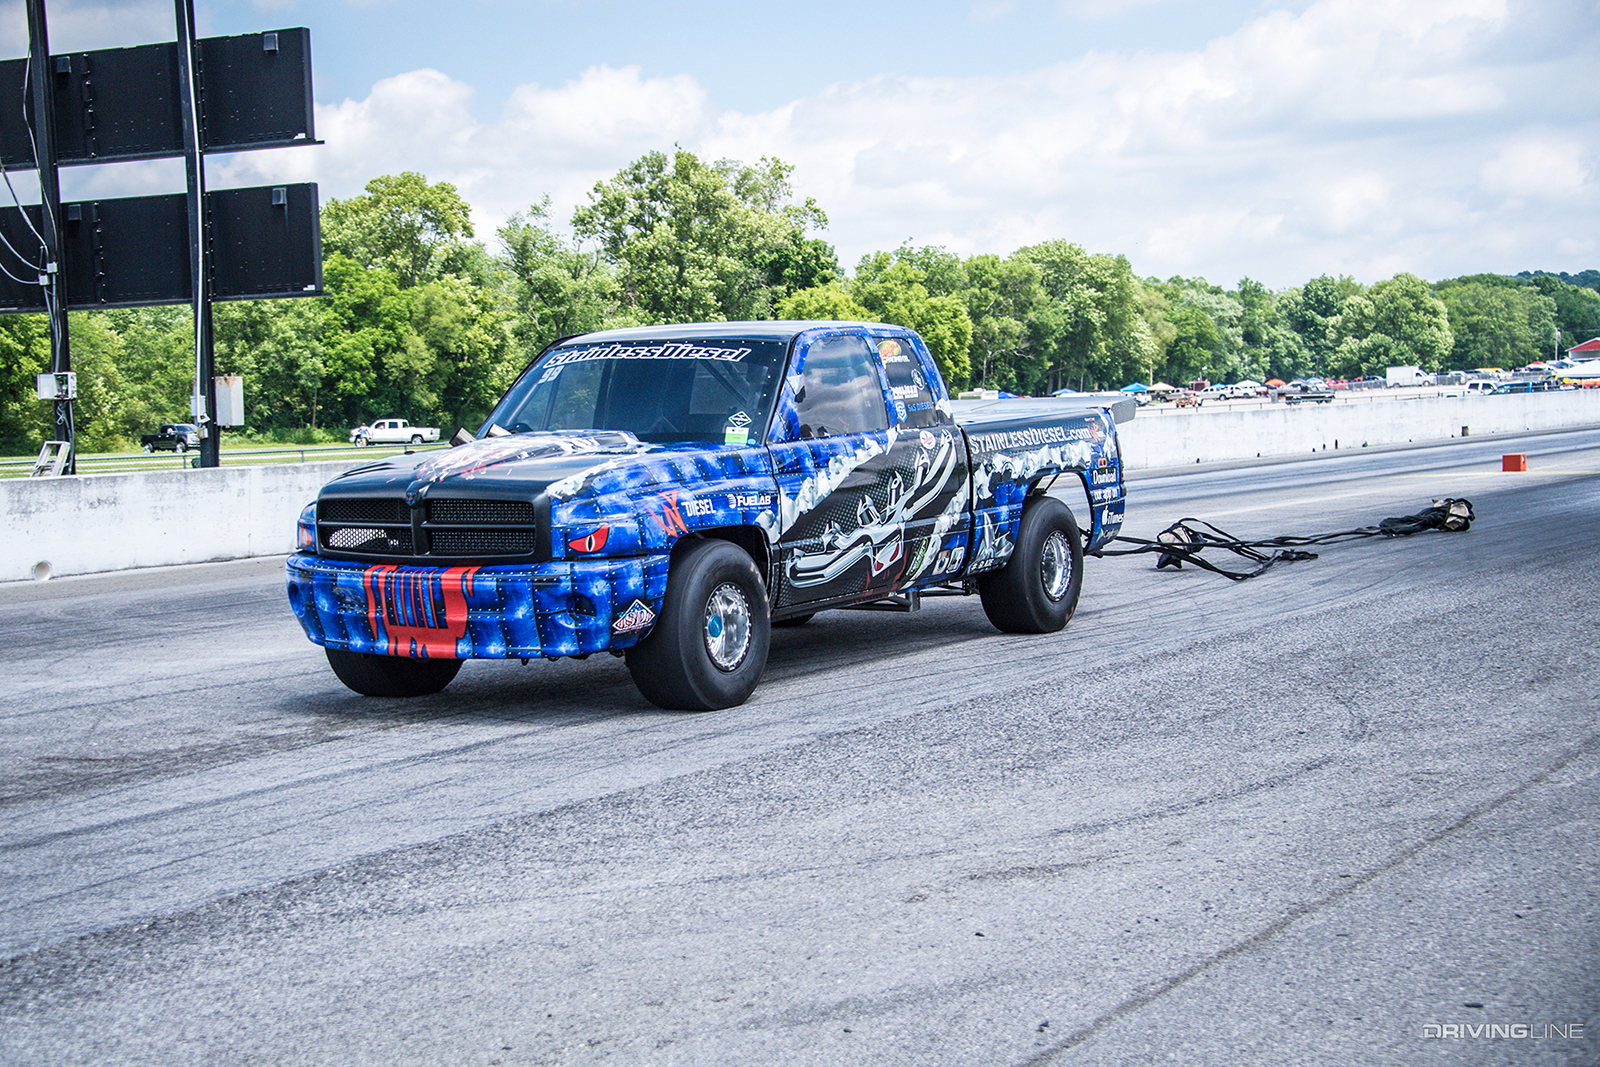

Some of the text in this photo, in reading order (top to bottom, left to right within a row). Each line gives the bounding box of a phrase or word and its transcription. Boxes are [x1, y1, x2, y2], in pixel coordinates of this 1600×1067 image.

[543, 342, 752, 369] StainlessDiesel
[538, 365, 565, 385] 99
[1093, 468, 1117, 485] Download
[681, 498, 716, 517] DIESEL
[736, 495, 772, 507] FUELAB
[1107, 512, 1124, 525] iTunes
